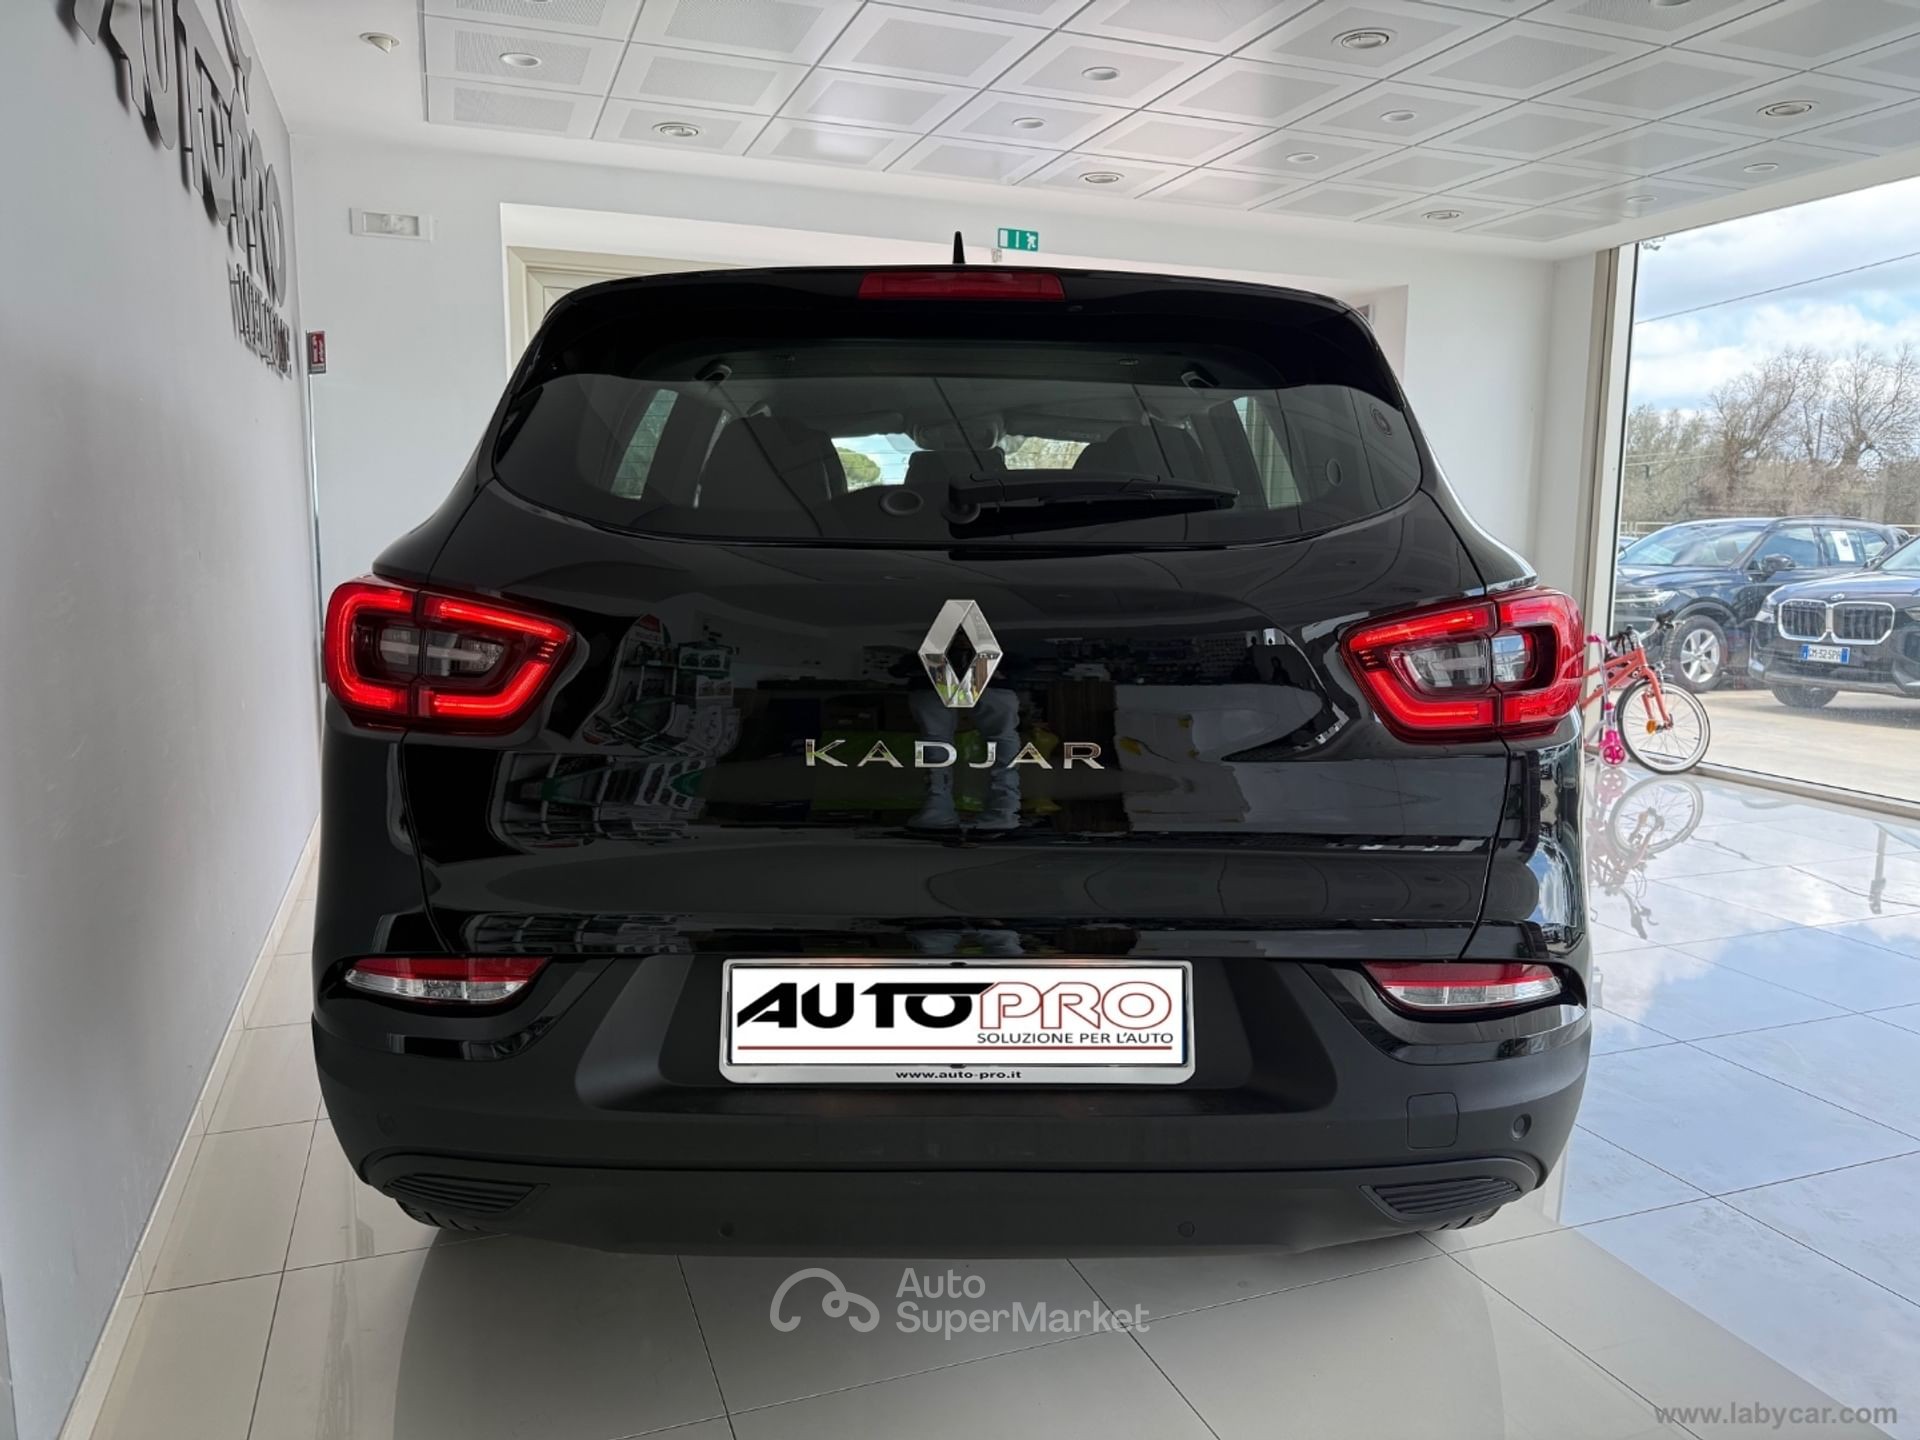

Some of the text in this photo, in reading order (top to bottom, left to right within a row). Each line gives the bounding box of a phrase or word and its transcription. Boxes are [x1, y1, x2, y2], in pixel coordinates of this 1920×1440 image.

[805, 739, 1105, 769] KADJAR
[737, 981, 1172, 1030] AUTOPRO
[977, 1032, 1174, 1044] SOLUZIONE PER L'AUTO
[895, 1070, 1022, 1082] www.auto-pro.it
